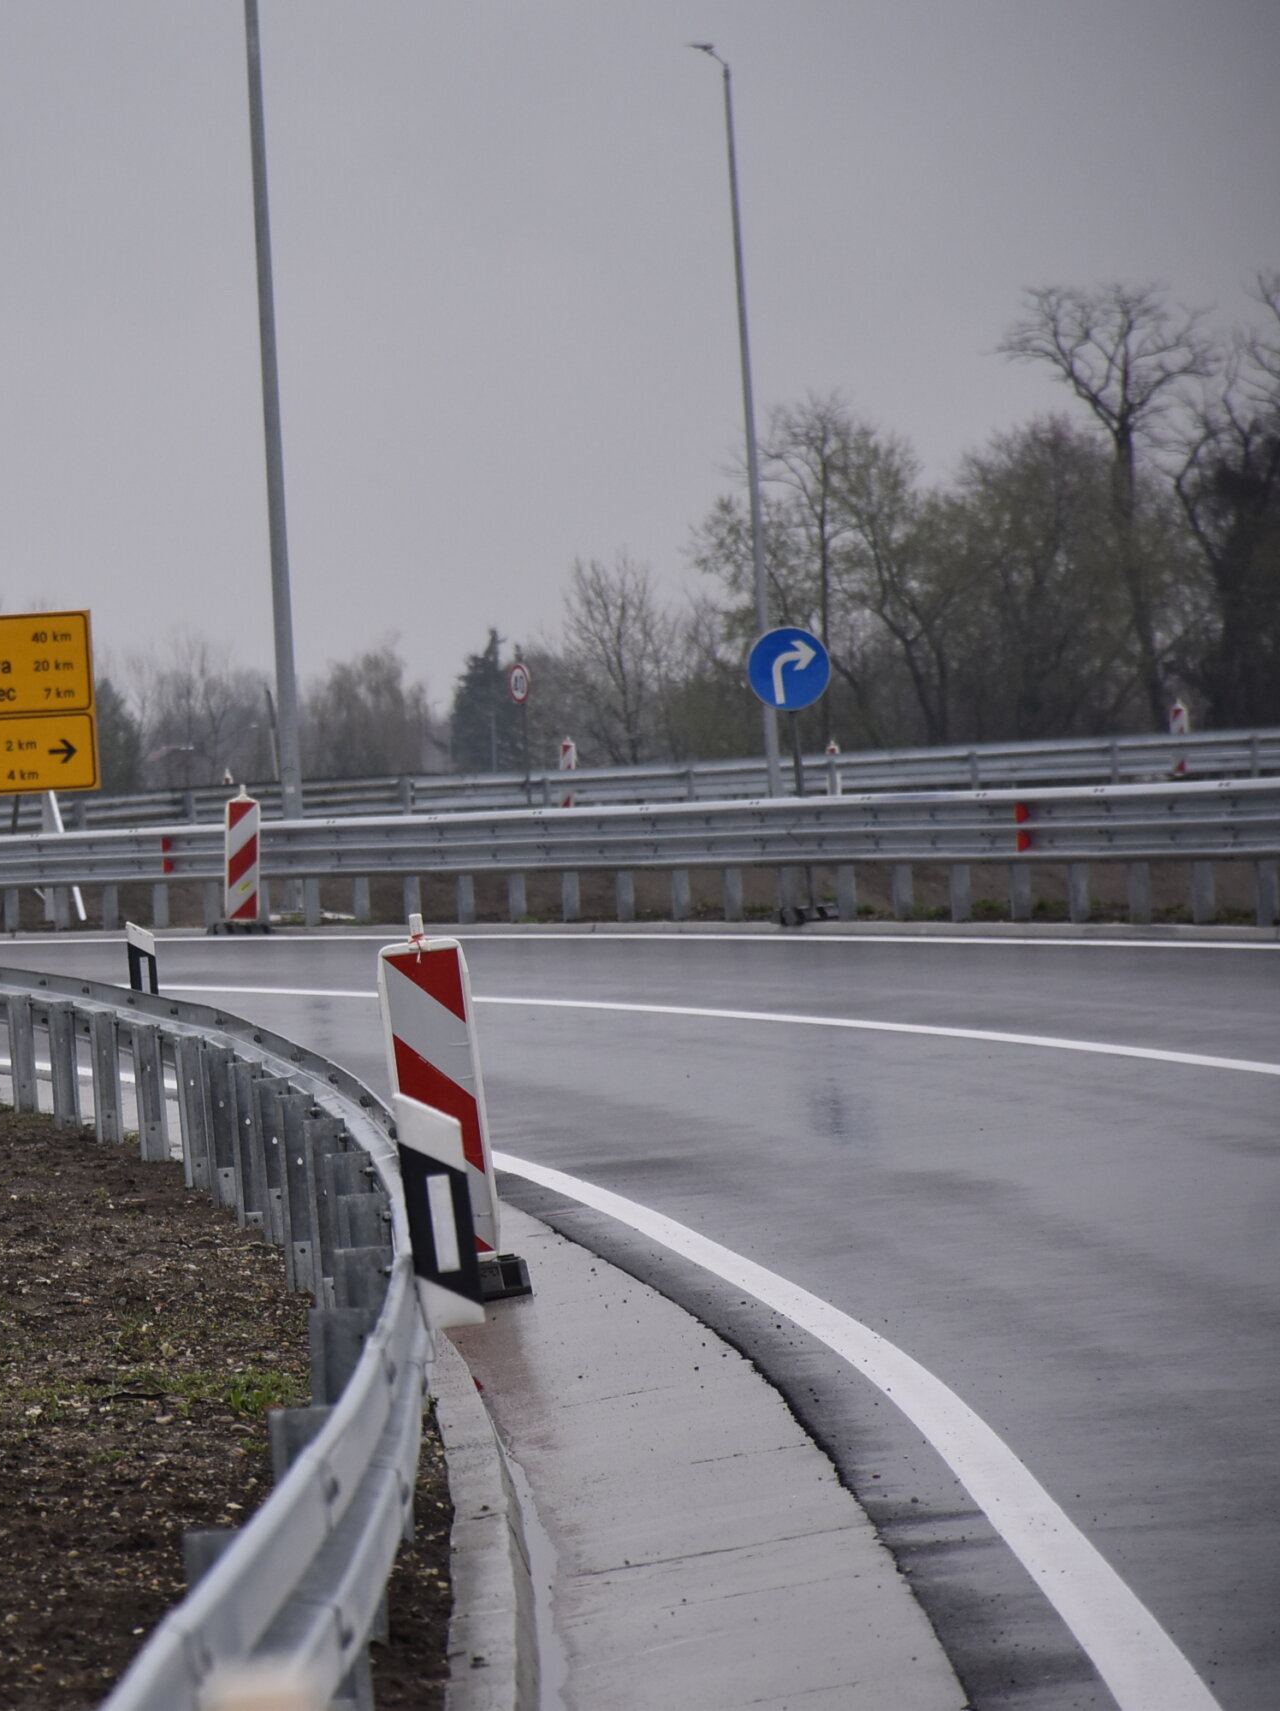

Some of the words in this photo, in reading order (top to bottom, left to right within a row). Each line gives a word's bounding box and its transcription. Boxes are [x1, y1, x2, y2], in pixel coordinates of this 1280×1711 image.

[31, 631, 48, 643] 40
[52, 631, 72, 642] km
[33, 660, 50, 672] 20
[55, 660, 74, 671] km
[44, 688, 52, 699] 7
[56, 688, 75, 699] km
[5, 740, 14, 752] 2
[17, 739, 37, 751] km
[7, 770, 16, 780] 4
[19, 769, 39, 780] km
